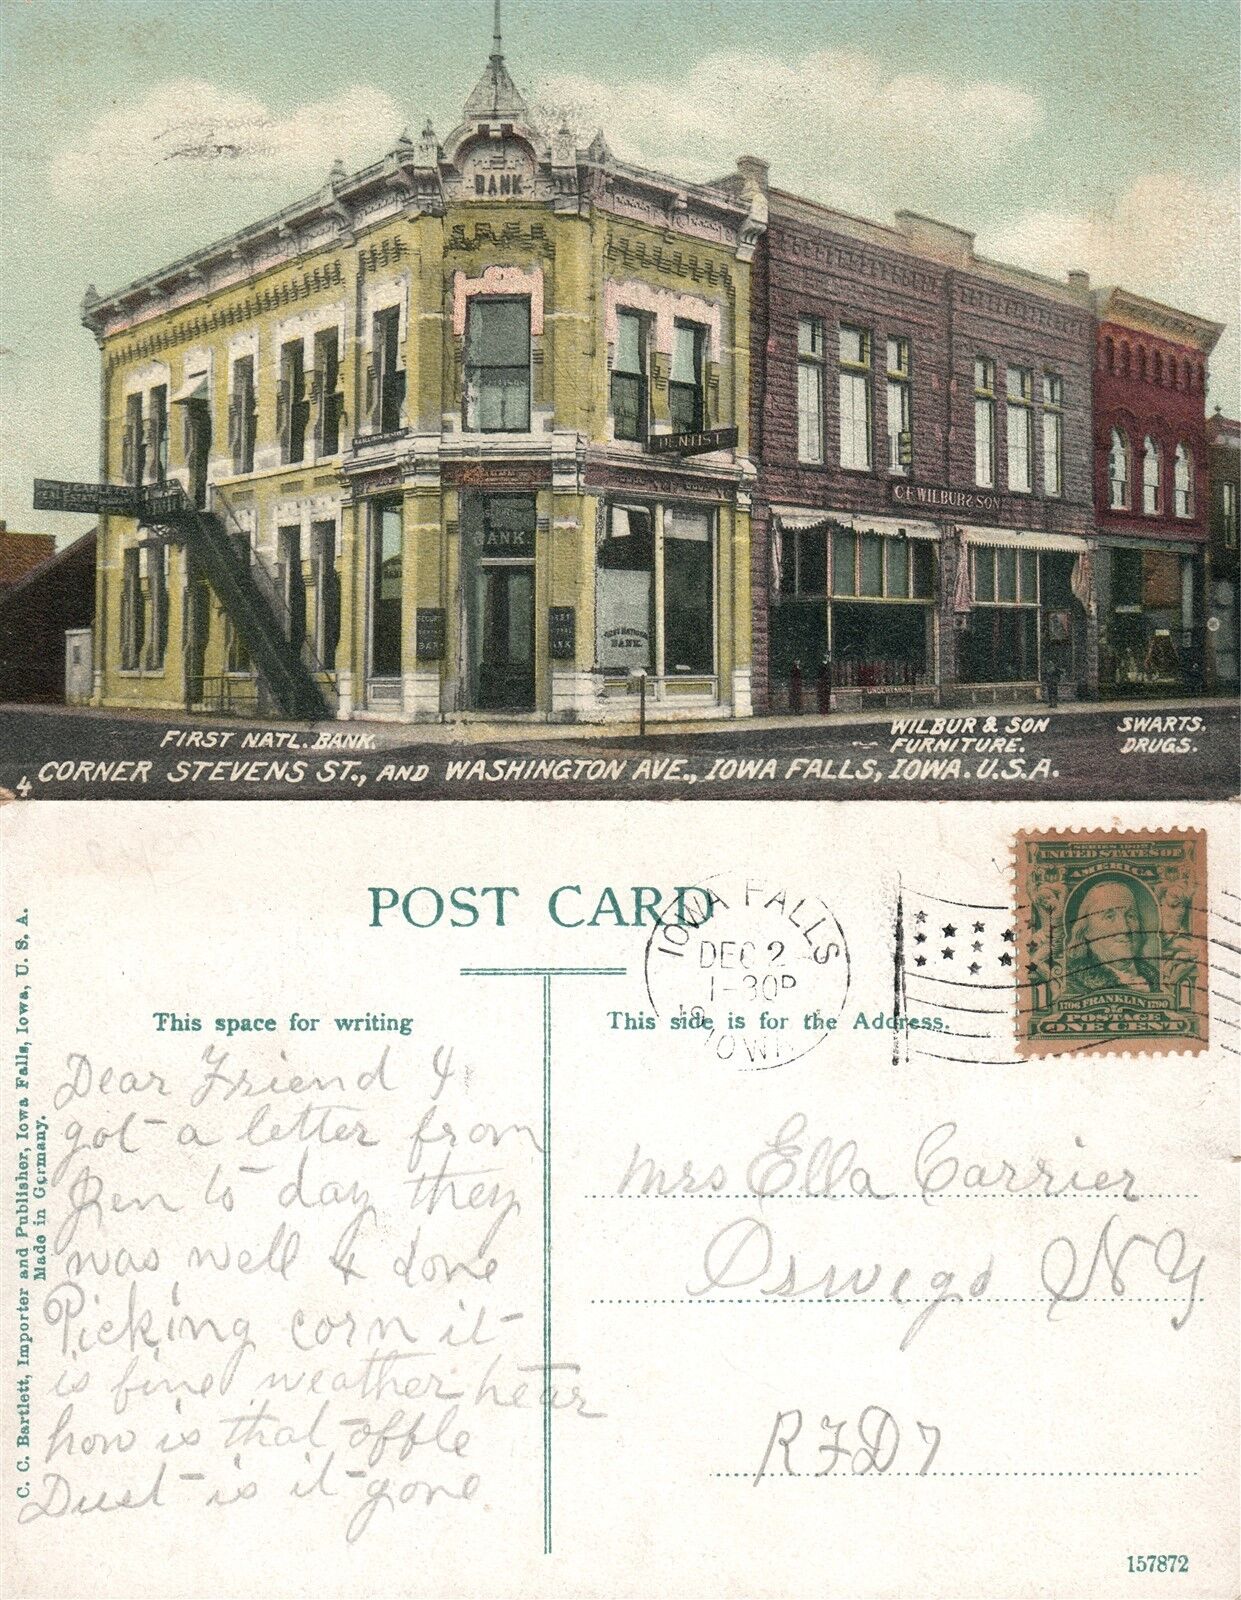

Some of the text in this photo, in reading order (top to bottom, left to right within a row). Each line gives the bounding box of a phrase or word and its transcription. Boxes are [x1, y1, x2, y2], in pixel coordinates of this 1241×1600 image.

[475, 174, 523, 195] BANK
[659, 432, 722, 448] DENTIST
[917, 487, 965, 506] WILBUR
[1040, 849, 1182, 859] UNITED STATES OF
[1070, 862, 1154, 878] AMERICA
[368, 884, 715, 929] POST CARD
[657, 878, 841, 965] IOWA FALLS
[699, 940, 786, 969] DEC 2
[15, 985, 32, 1035] Iowa,
[152, 1011, 414, 1037] This space for writing
[606, 1009, 951, 1031] This side is for the Address.
[1066, 1013, 1161, 1022] POSTAGE
[1082, 994, 1146, 1008] FRANKLIN
[1046, 1022, 1184, 1032] ONE CENT
[15, 1041, 32, 1090] Falls,
[53, 1052, 172, 1111] Dear
[190, 1044, 399, 1108] Friend
[15, 1096, 29, 1140] Iowa
[50, 1101, 546, 1188] got a letter from
[745, 1111, 896, 1209] Ella
[914, 1121, 1140, 1207] Carrier
[15, 1147, 33, 1239] Publisher,
[32, 1114, 49, 1282] Made in Germany.
[402, 1150, 521, 1259] they
[16, 1248, 29, 1280] and
[65, 1246, 160, 1278] was
[187, 1220, 301, 1282] well
[392, 1225, 499, 1289] done
[685, 1216, 997, 1352] Oswego
[16, 1287, 34, 1367] Importer
[43, 1280, 523, 1396] Picking corn it
[48, 1350, 91, 1398] is
[109, 1347, 214, 1415] fine
[254, 1347, 466, 1401] weather
[16, 1374, 33, 1448] Bartlett,
[45, 1402, 137, 1464] how
[155, 1398, 201, 1453] is
[218, 1399, 360, 1449] that
[16, 1455, 30, 1473] C.
[915, 1420, 942, 1478] 7
[16, 1481, 30, 1499] C.
[205, 1452, 259, 1506] is
[290, 1451, 360, 1498] it
[345, 1472, 482, 1544] gone
[1126, 1554, 1190, 1573] 157872
